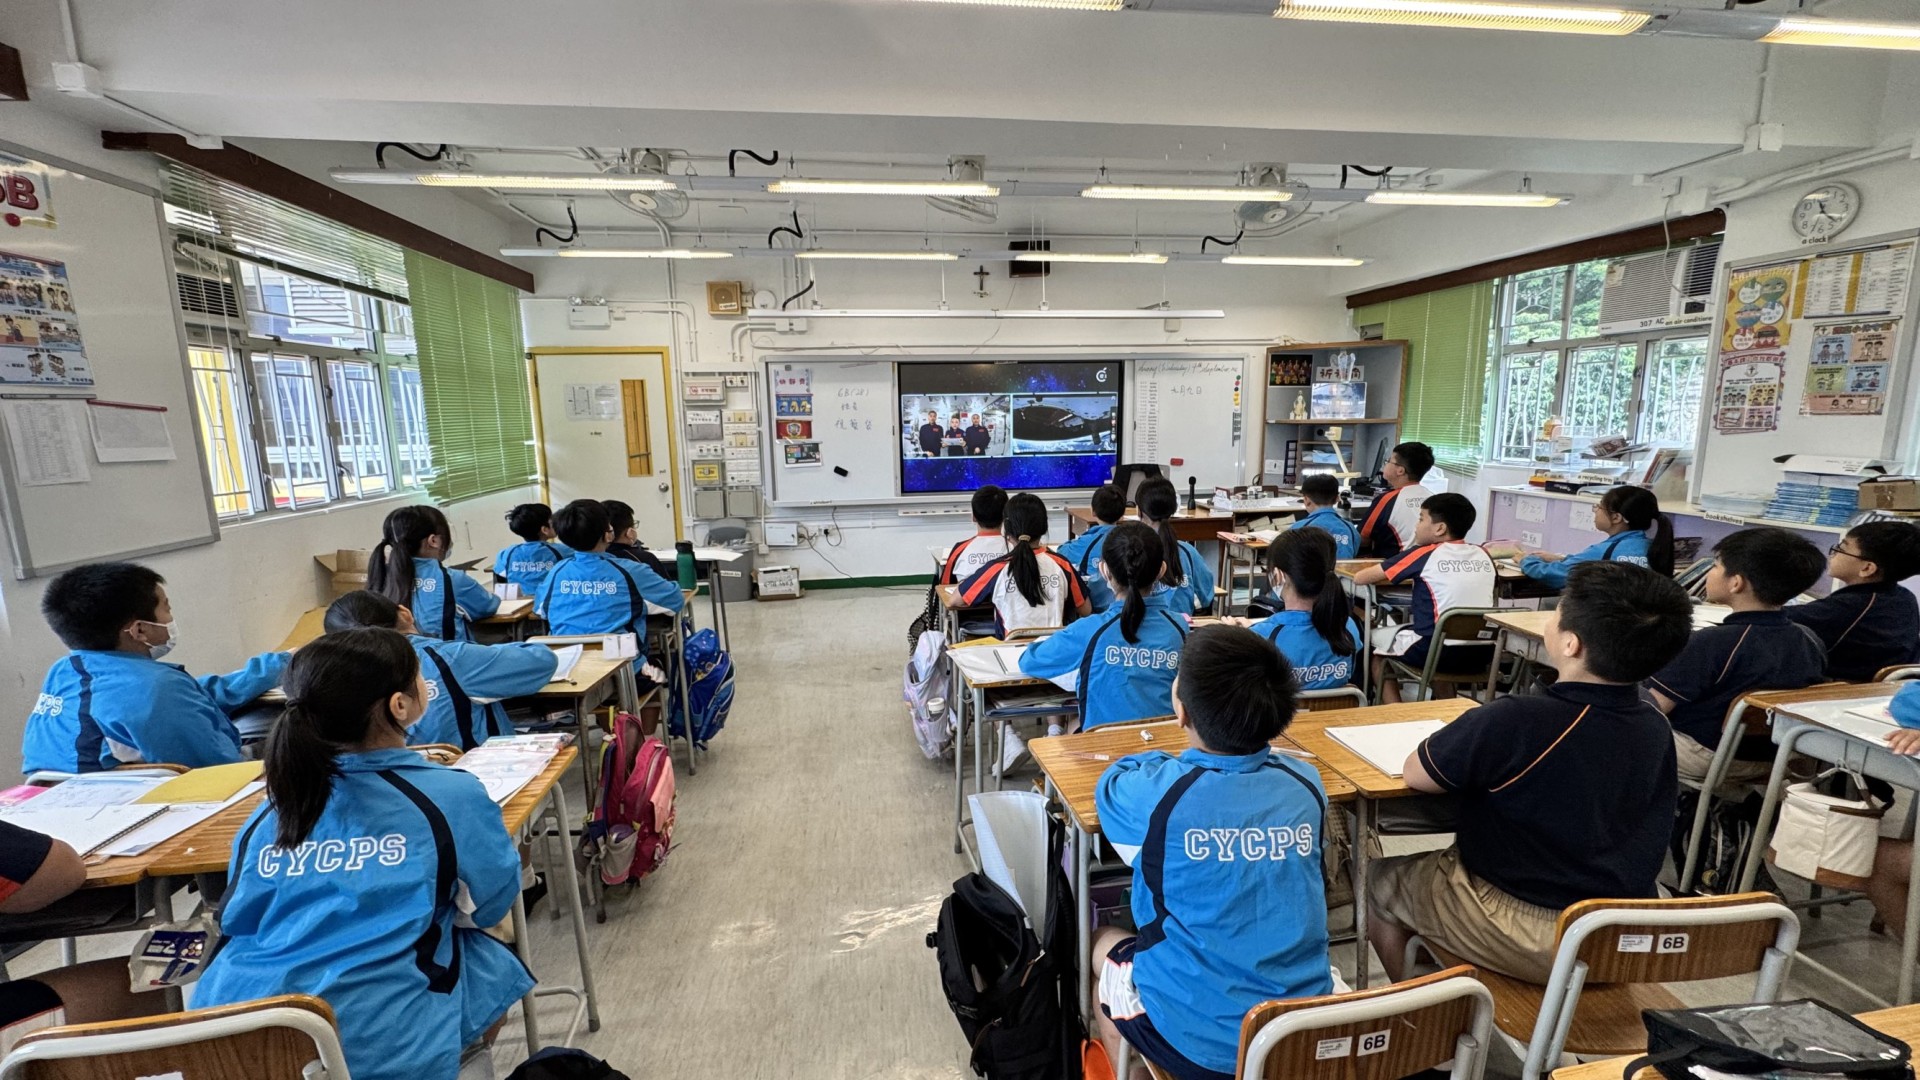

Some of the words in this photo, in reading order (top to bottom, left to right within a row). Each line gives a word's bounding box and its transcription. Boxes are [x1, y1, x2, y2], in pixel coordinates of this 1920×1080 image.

[1438, 559, 1492, 573] CYCPS
[560, 580, 617, 595] CYCPS
[1105, 645, 1178, 669] CYCPS
[1184, 823, 1313, 862] CYCPS
[258, 833, 407, 879] CYCPS
[1663, 936, 1685, 950] 6B
[1363, 1034, 1386, 1051] 6B
